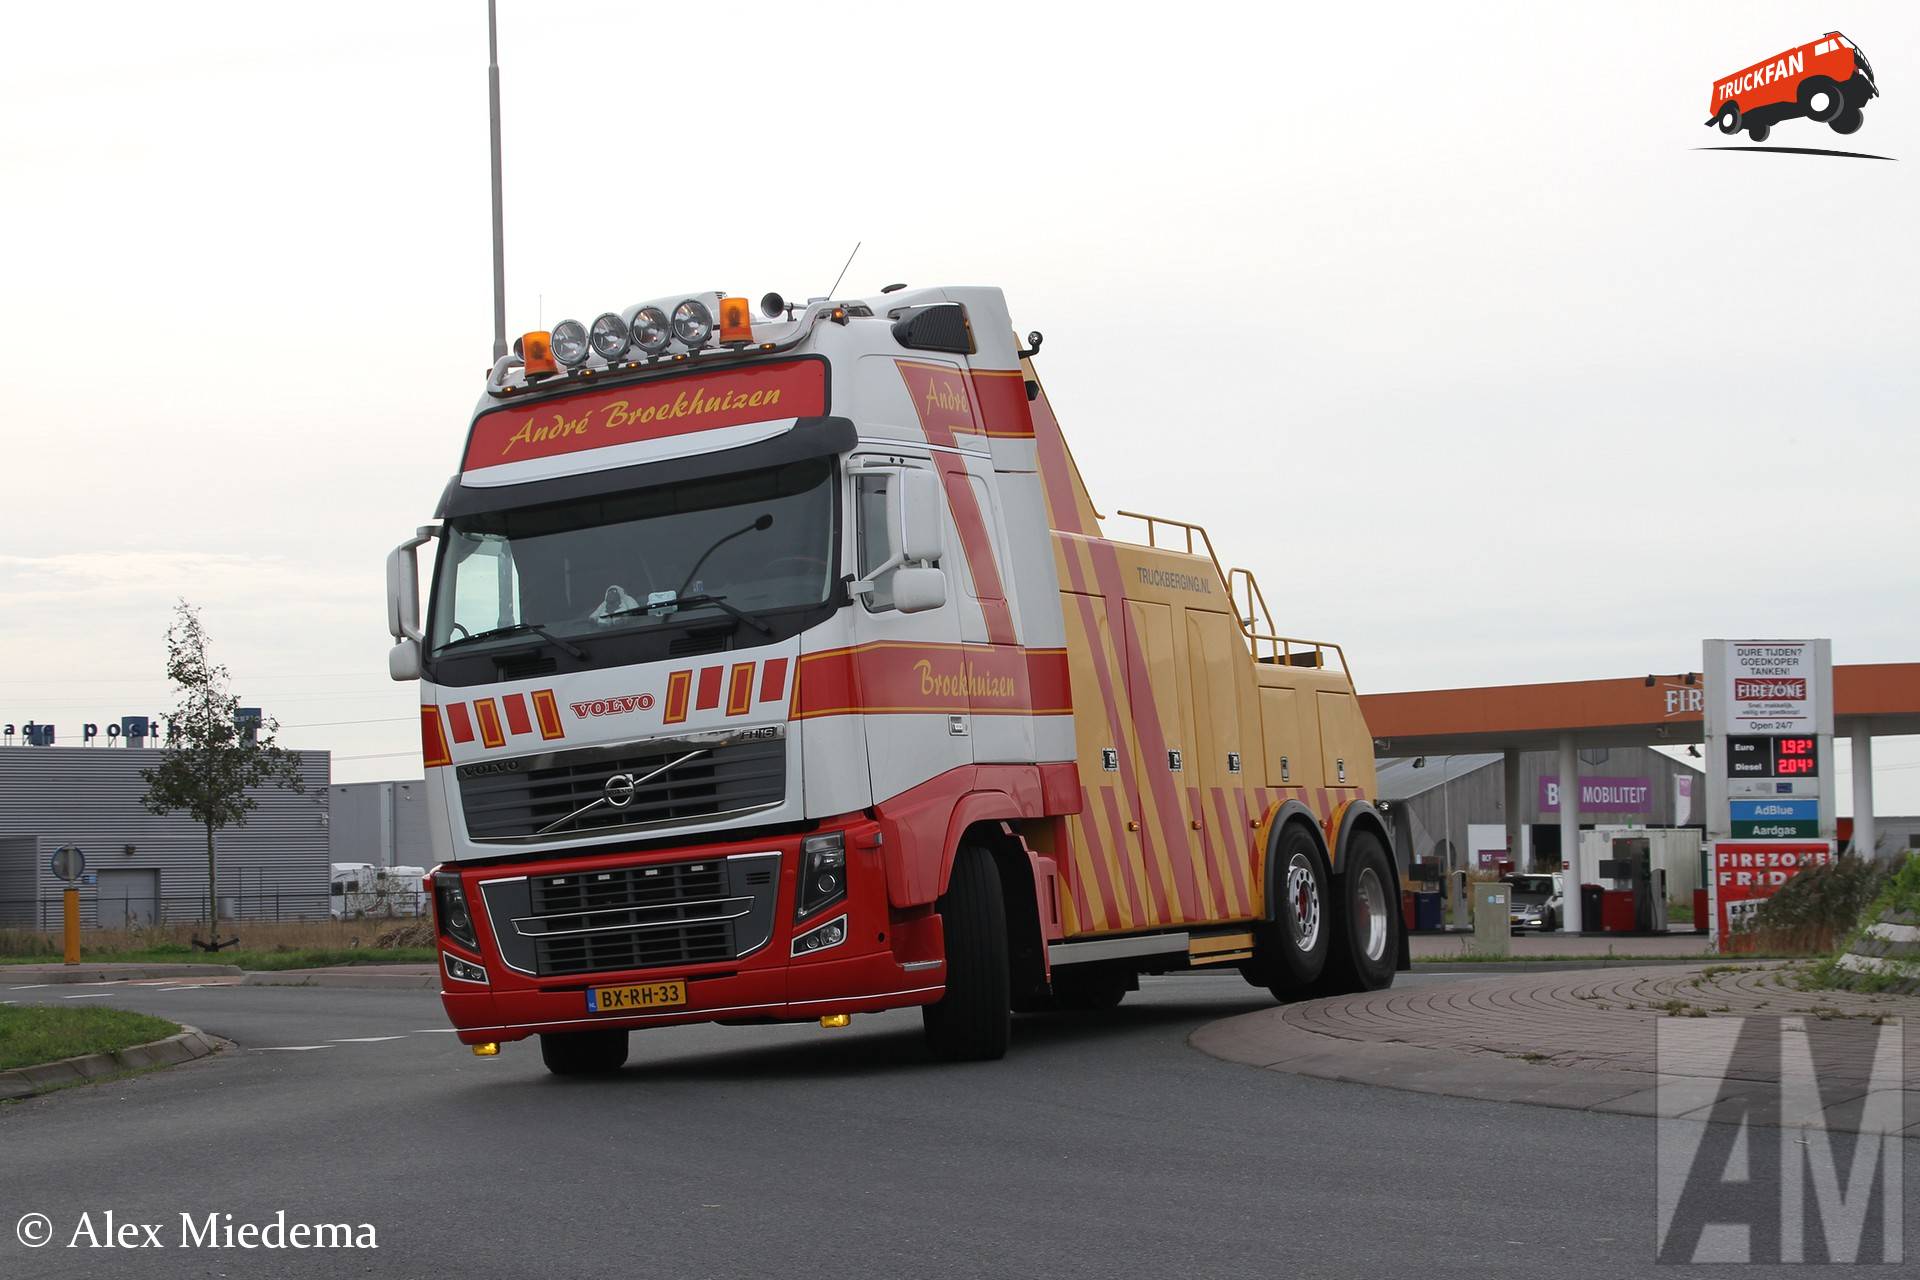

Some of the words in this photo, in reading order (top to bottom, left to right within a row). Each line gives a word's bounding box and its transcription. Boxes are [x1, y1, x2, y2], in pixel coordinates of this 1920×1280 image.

[926, 377, 969, 415] André
[502, 411, 592, 455] André
[600, 387, 782, 428] Broekhuizen
[1136, 567, 1211, 594] TRUCKBERGING.NL
[1737, 648, 1763, 657] DURE
[1766, 648, 1803, 657] TIJDEN?
[1741, 657, 1800, 667] GOEDKOPER
[913, 659, 1015, 697] Broekhuizen
[1750, 667, 1791, 676] TANKEN!
[1737, 684, 1804, 697] FIREZONE
[570, 693, 655, 719] VOLVO
[1665, 688, 1704, 713] FIR
[1750, 722, 1774, 731] Open
[1776, 722, 1793, 730] 24/7
[461, 760, 519, 777] VOLVO
[1735, 763, 1762, 771] Diesel
[1547, 783, 1561, 805] B
[1583, 787, 1647, 803] MOBILITEIT
[1755, 805, 1794, 815] AdBlue
[1752, 825, 1797, 837] Aardgas
[1719, 871, 1799, 885] FRID
[602, 985, 679, 1007] BX-RH-33
